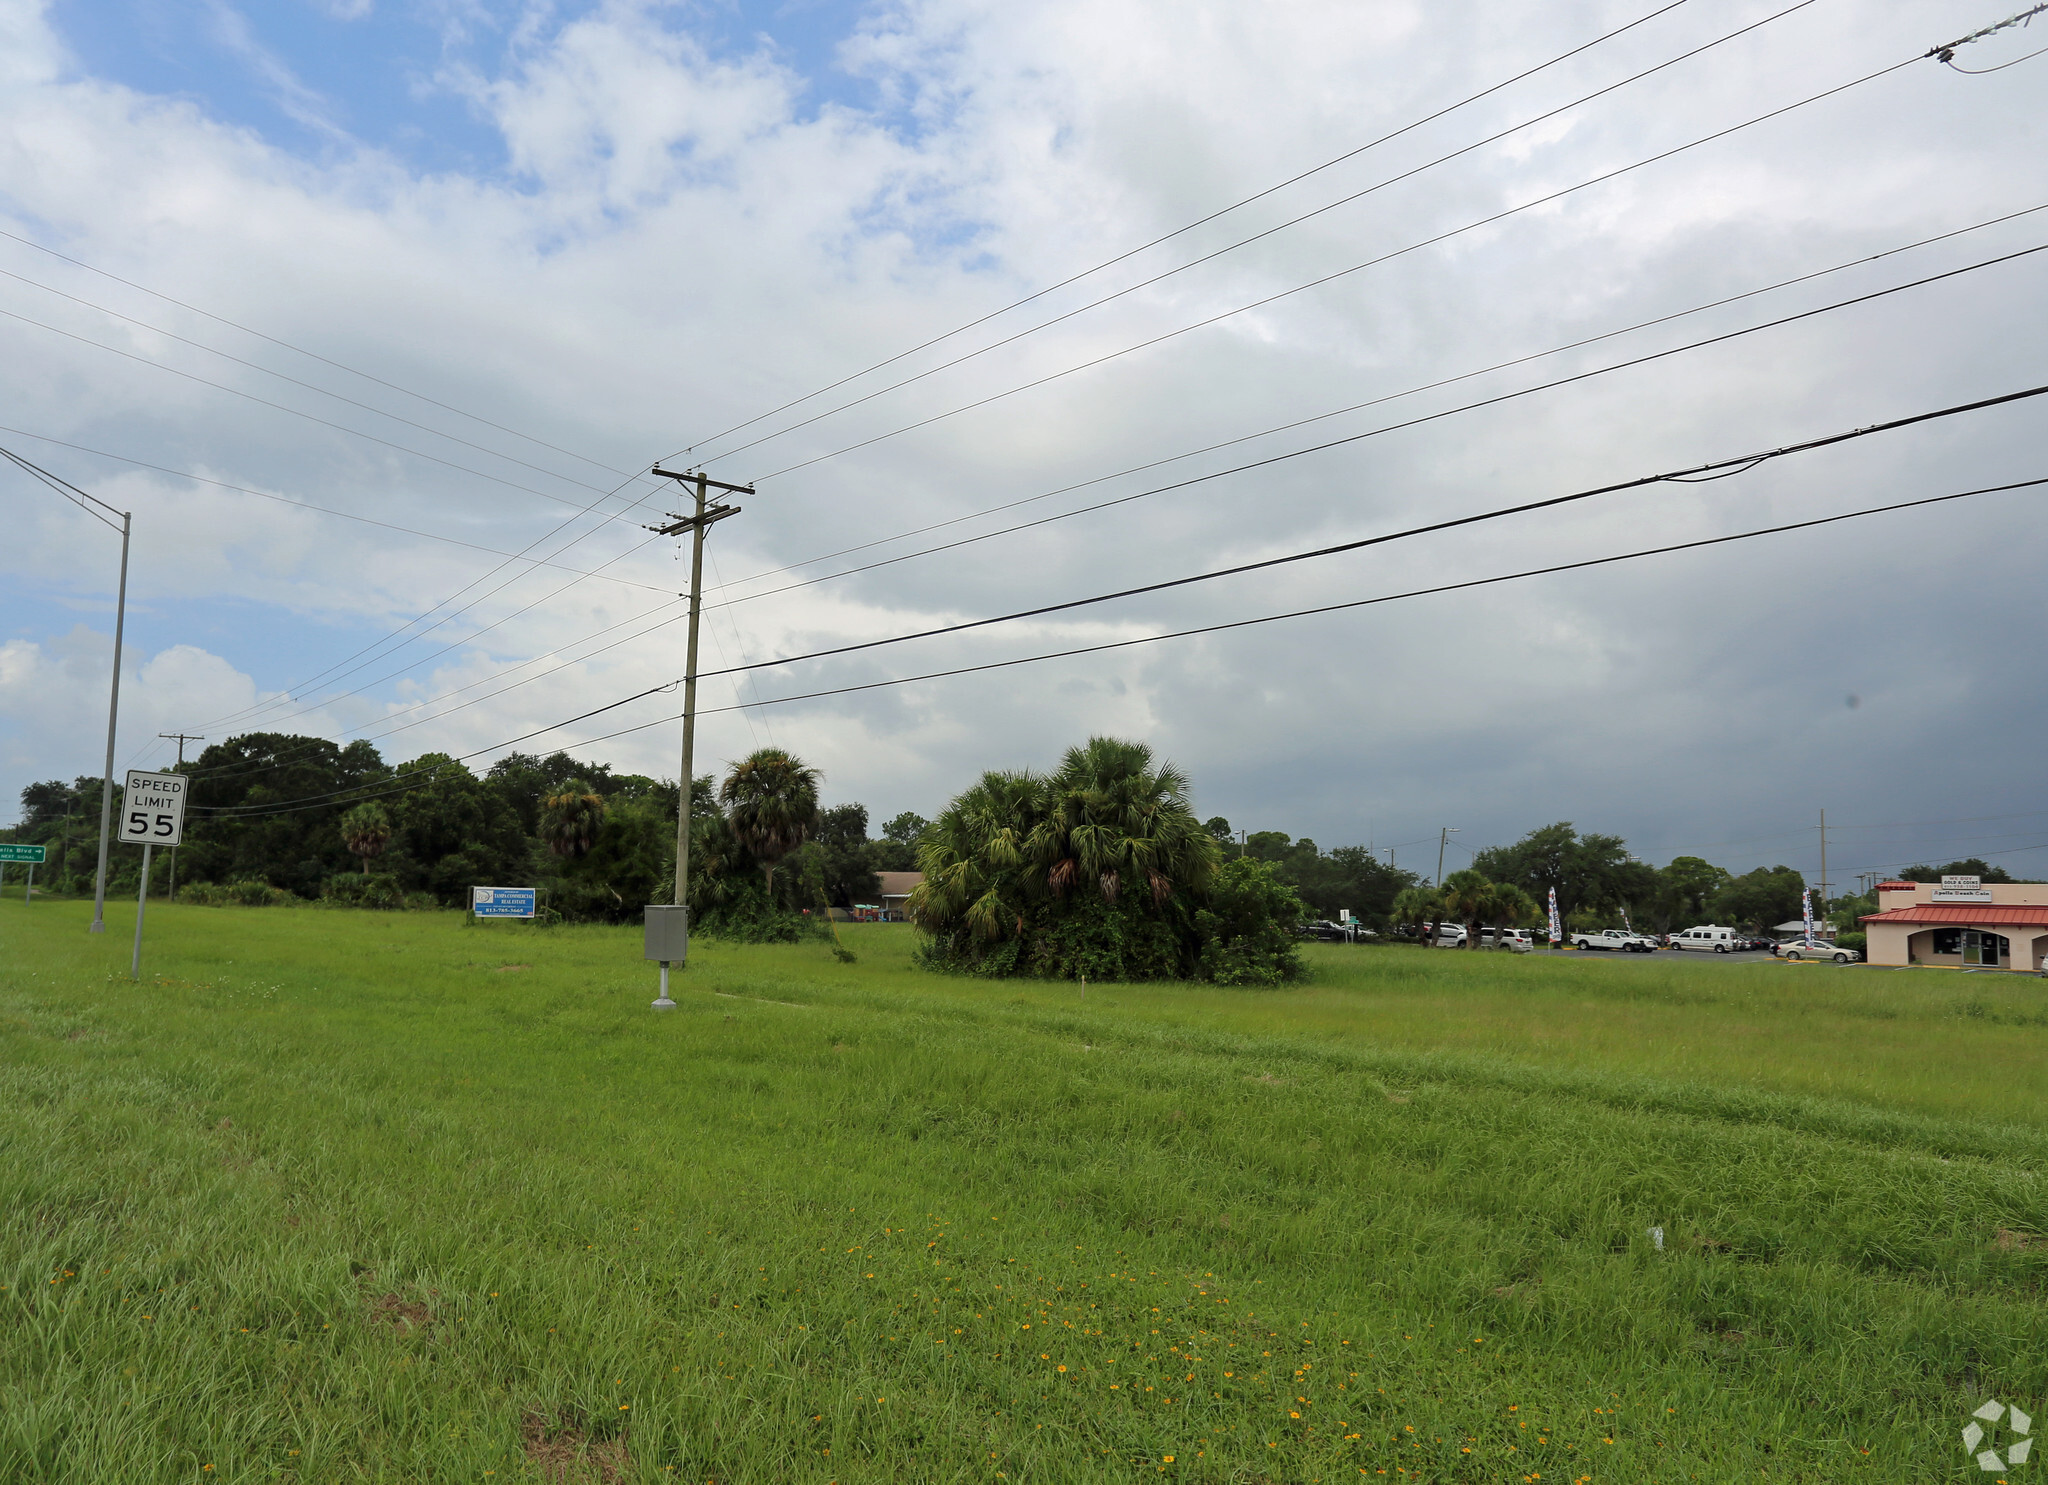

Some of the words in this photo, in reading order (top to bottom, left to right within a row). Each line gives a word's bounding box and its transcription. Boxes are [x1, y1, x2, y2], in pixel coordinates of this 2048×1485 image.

[131, 778, 181, 793] SPEED
[135, 795, 174, 808] LIMIT
[128, 811, 174, 837] 55
